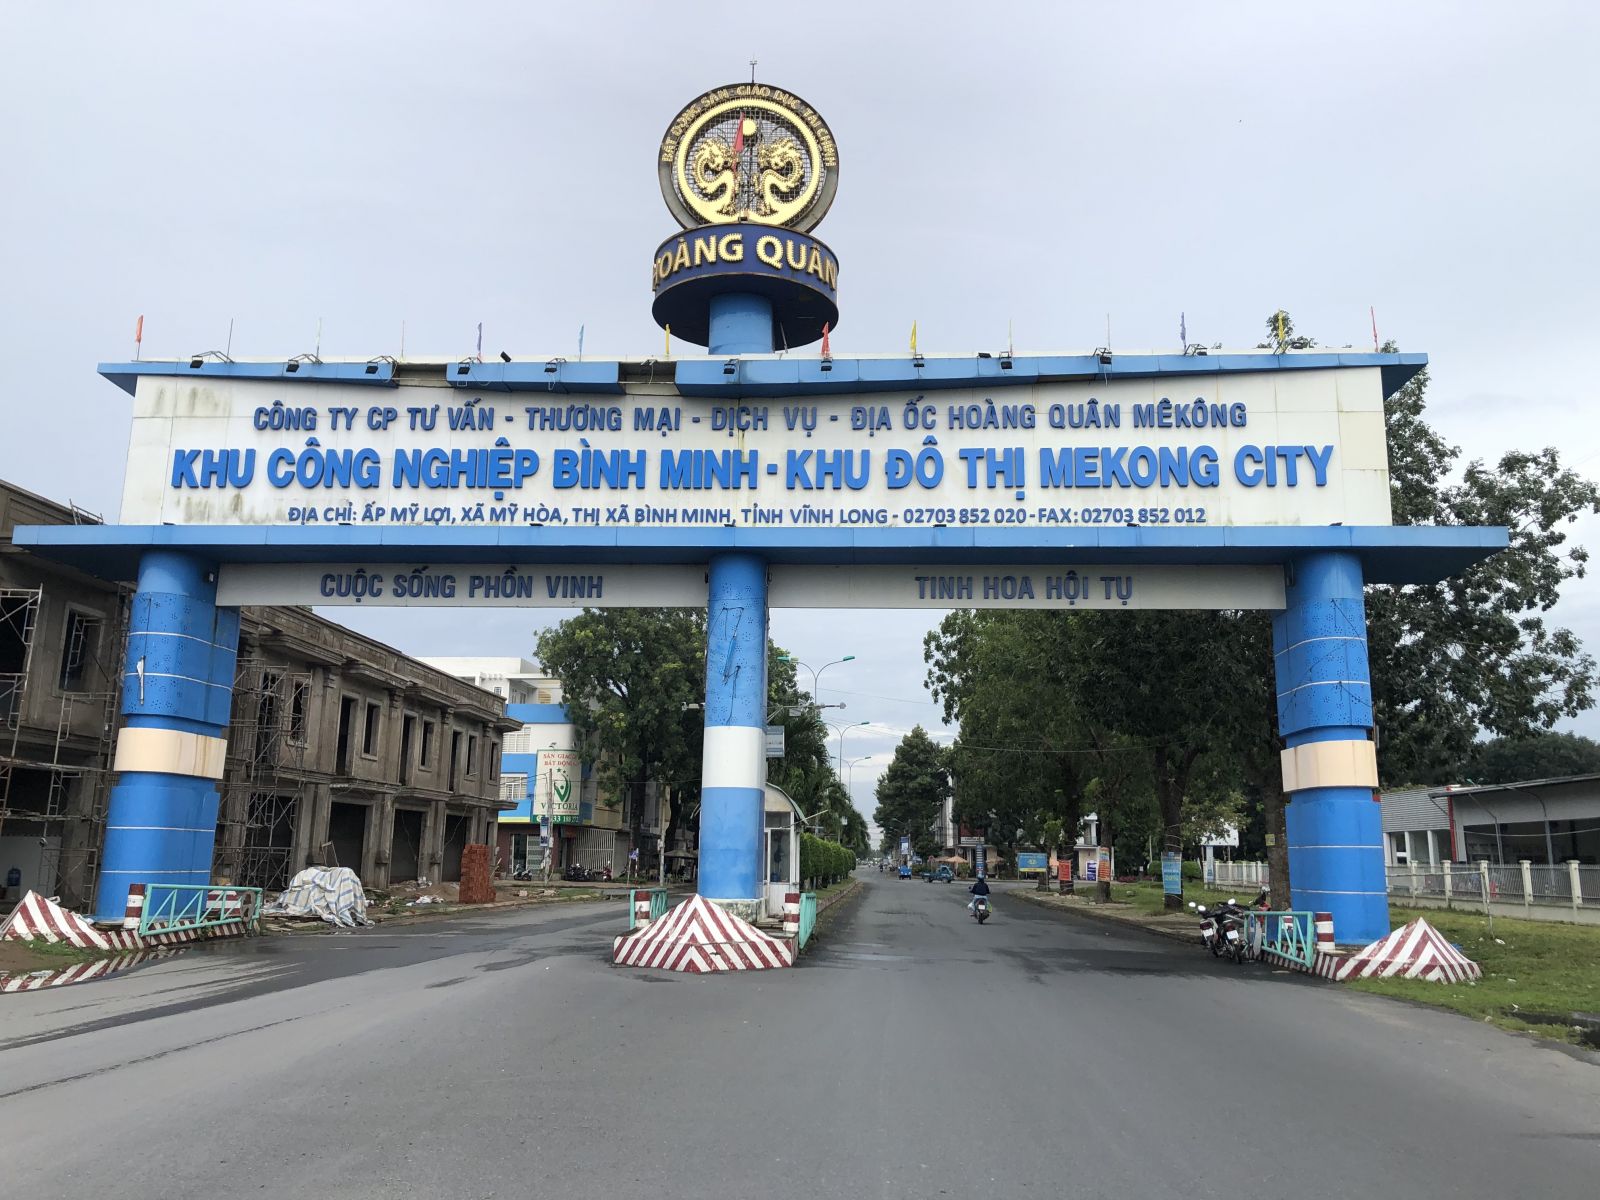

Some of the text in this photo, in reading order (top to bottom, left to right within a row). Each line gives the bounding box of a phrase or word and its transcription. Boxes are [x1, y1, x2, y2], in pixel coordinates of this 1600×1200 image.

[756, 235, 837, 291] QUÂN
[254, 400, 317, 431] CÔNG
[328, 408, 358, 431] TY
[367, 407, 398, 431] CP
[407, 404, 440, 431] TƯ
[448, 398, 494, 431] VẤN
[525, 404, 622, 431] THƯƠNG
[634, 407, 681, 437] MẠI
[711, 407, 769, 437] DỊCH
[784, 407, 818, 437] VỤ
[851, 405, 892, 437] ĐỊA
[903, 395, 936, 430] ỐC
[948, 398, 1035, 429] HOÀNG
[1049, 398, 1120, 429] QUÂN
[1133, 398, 1246, 429] MÊKÔNG
[171, 449, 256, 489] KHU
[267, 437, 380, 489] CÔNG
[393, 437, 539, 500] NGHIỆP
[553, 438, 646, 489] BÌNH
[660, 450, 758, 489] MINH
[786, 449, 870, 490] KHU
[885, 435, 944, 489] ĐÔ
[959, 447, 1025, 500] THỊ
[1040, 445, 1219, 488] MEKONG
[1234, 445, 1333, 488] CITY
[288, 507, 318, 525] ĐỊA
[324, 501, 356, 522] CHỈ:
[362, 501, 385, 522] ẤP
[391, 503, 419, 522] MỸ
[461, 503, 484, 522] XÃ
[490, 503, 518, 522] MỸ
[572, 507, 600, 526] THỊ
[606, 504, 629, 523] XÃ
[635, 503, 677, 523] BÌNH
[741, 502, 782, 524] TỈNH
[790, 504, 833, 524] VĨNH
[840, 508, 887, 524] LONG
[904, 508, 956, 524] 02703
[959, 508, 989, 524] 852
[995, 508, 1027, 524] 020
[1082, 508, 1133, 523] 02703
[1138, 508, 1169, 523] 852
[1175, 508, 1206, 523] 012
[320, 566, 603, 603] CUỘC SỐNG PHỒN VINH
[916, 570, 1133, 605] TINH HOA HỘI TỤ
